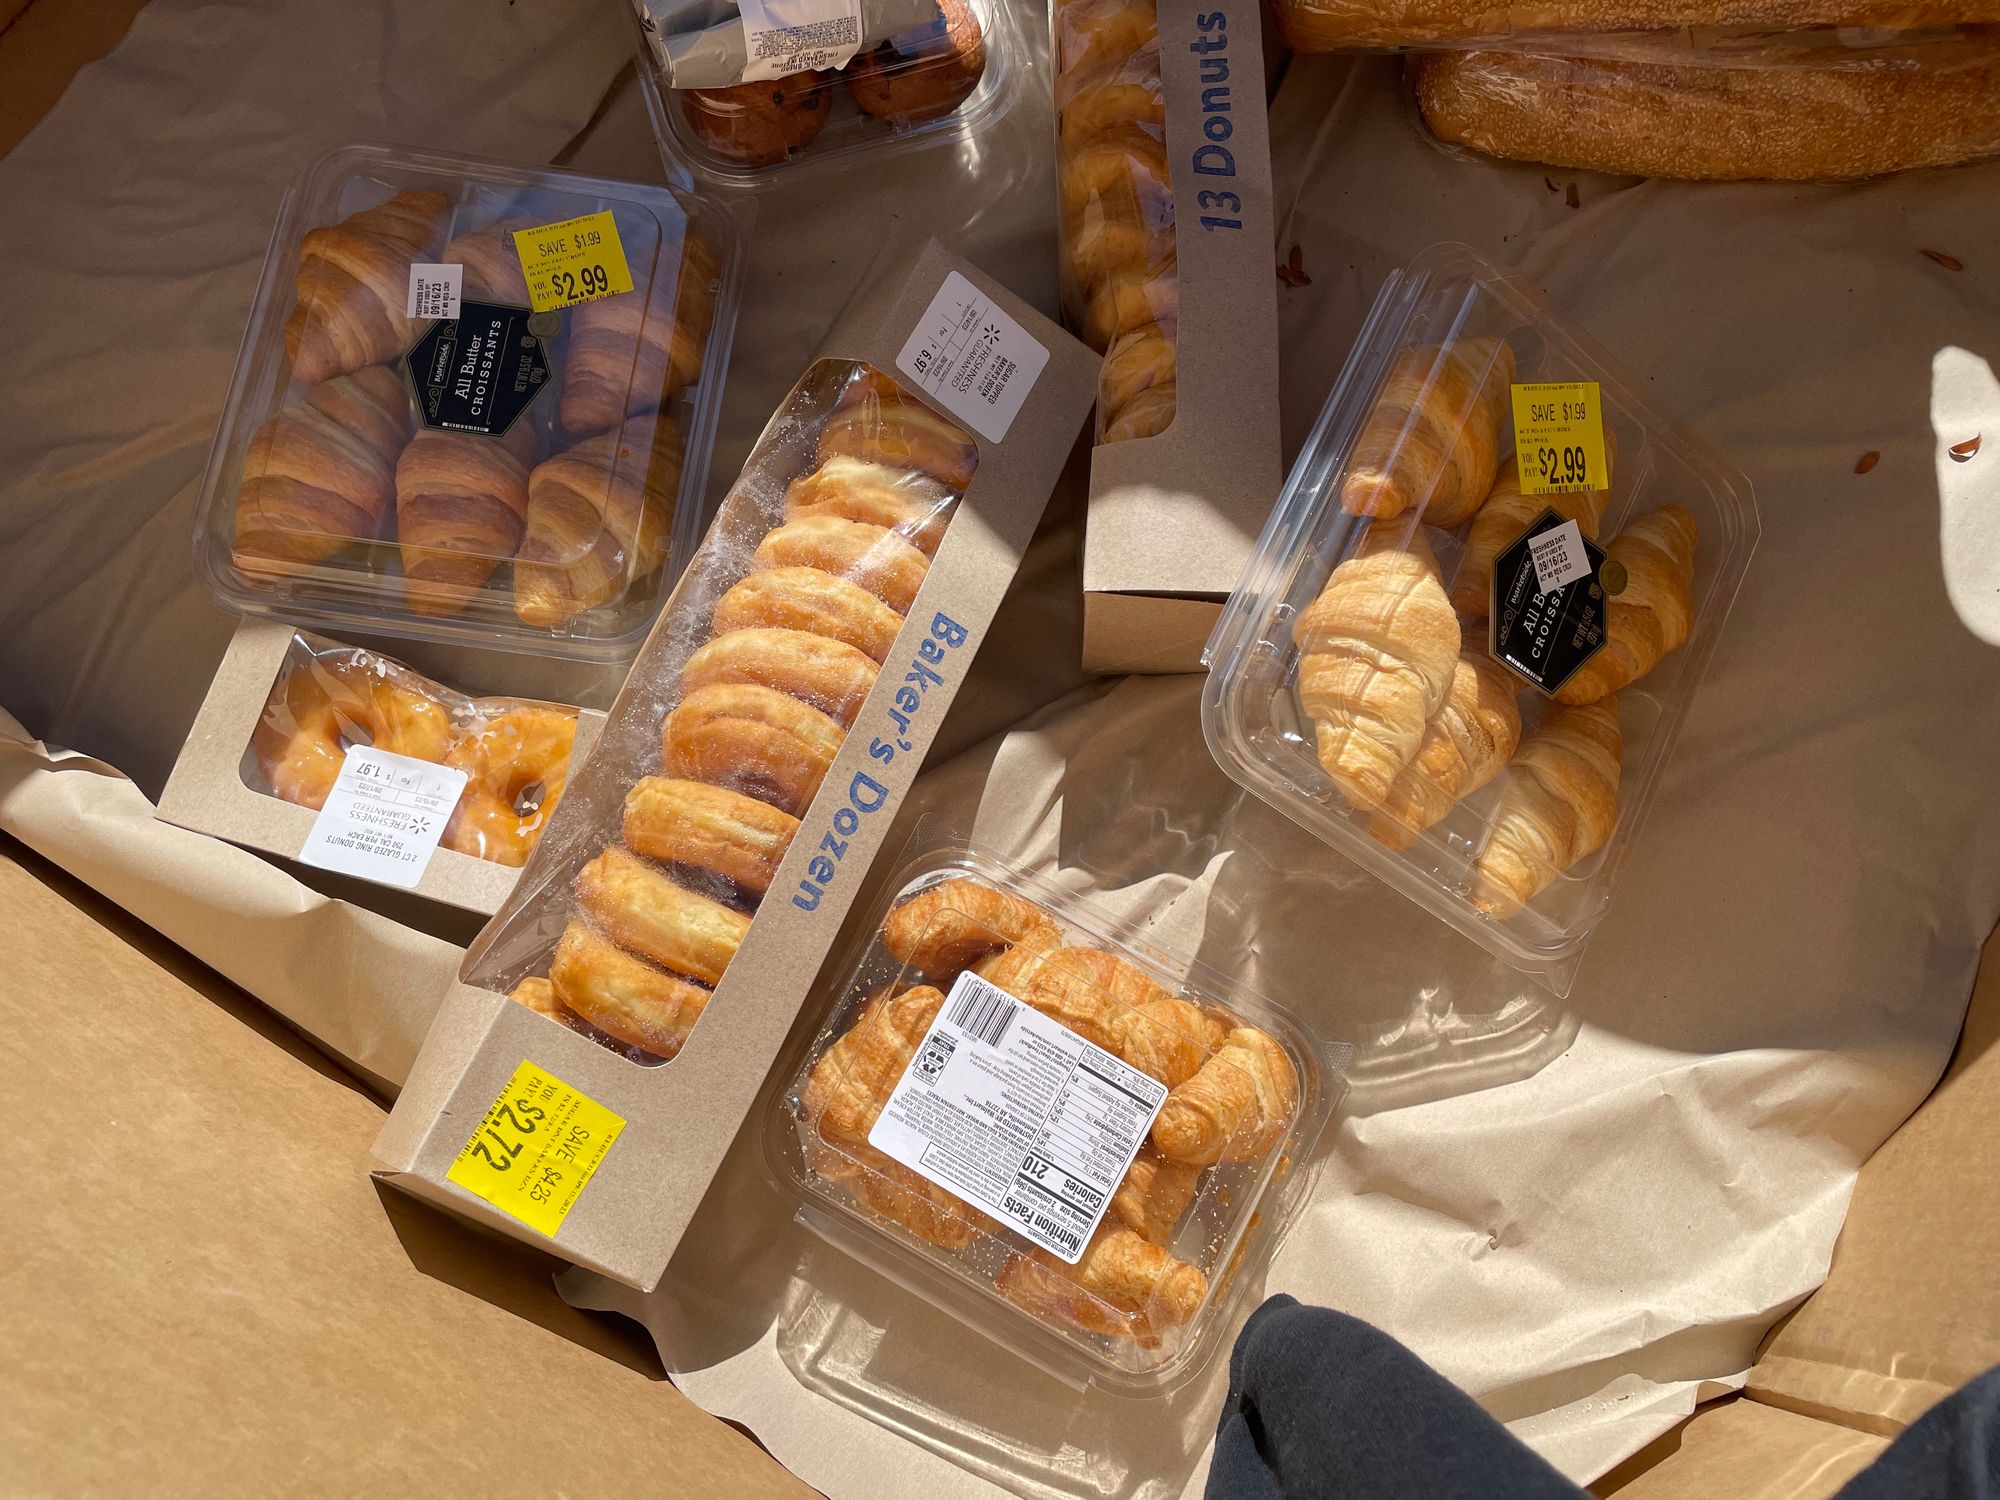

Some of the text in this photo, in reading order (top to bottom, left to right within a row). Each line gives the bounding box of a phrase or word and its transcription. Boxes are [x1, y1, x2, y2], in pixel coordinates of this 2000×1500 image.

[1190, 10, 1242, 231] 13 Donuts
[538, 229, 601, 257] SAVE $1.99
[533, 281, 546, 290] YOU
[550, 263, 609, 300] $2.99
[430, 282, 441, 314] 09/16/23
[960, 309, 977, 330] 09/14/23
[937, 326, 947, 337] For
[433, 342, 449, 382] Marketside
[454, 333, 482, 399] All Butter
[470, 319, 501, 416] CROISSANTS
[911, 348, 933, 373] 6.97
[949, 338, 984, 387] GUARANTEED
[957, 344, 993, 394] FRESHNESS
[979, 356, 1009, 397] BAKER'S DOZEN
[986, 360, 1017, 405] SUGAR TOPPED
[1531, 399, 1586, 423] SAVE $1.99
[1537, 445, 1586, 484] $2.99
[1554, 533, 1566, 544] DATE
[1537, 551, 1568, 572] 09/16/23
[1509, 559, 1532, 603] Marketside
[1520, 607, 1541, 635] All
[1530, 584, 1566, 659] CROISSA
[356, 761, 381, 777] 1.97
[790, 611, 970, 913] Baker's Dozen
[358, 781, 382, 793] 09/17/23
[400, 776, 410, 784] For
[348, 809, 407, 830] FRESHNESS
[352, 801, 411, 820] GUARANTEED
[347, 830, 364, 840] EACH
[364, 834, 378, 843] PER
[378, 837, 391, 846] CAL
[325, 834, 417, 862] 2 CT GLAZED RING DONUTS
[937, 1039, 950, 1049] TRAY
[522, 1075, 542, 1098] PAY!
[538, 1082, 557, 1103] YOU
[560, 1099, 581, 1126] SUGAR
[972, 1100, 995, 1118] Walmart
[984, 1099, 1037, 1134] Bentonville, AR 72716
[993, 1113, 1003, 1122] BY:
[1133, 1102, 1151, 1115] Protein
[470, 1095, 548, 1171] $2.72
[1001, 1118, 1034, 1140] DISTRIBUTED
[1092, 1117, 1123, 1140] Carbohydrate
[1099, 1143, 1125, 1162] Cholesterol
[1111, 1141, 1130, 1154] Sodium
[1120, 1135, 1134, 1147] Total
[526, 1123, 590, 1206] SAVE $4.25
[1020, 1154, 1049, 1180] 210
[1091, 1170, 1100, 1179] Fat
[1099, 1175, 1112, 1186] Total
[1012, 1176, 1091, 1228] Serving size 2 croissants (56g)
[1013, 1188, 1038, 1206] container
[1061, 1177, 1103, 1209] Calories
[1036, 1201, 1047, 1211] per
[1044, 1206, 1068, 1224] servings
[1001, 1195, 1081, 1251] Nutrition Facts
[1069, 1222, 1086, 1236] about
